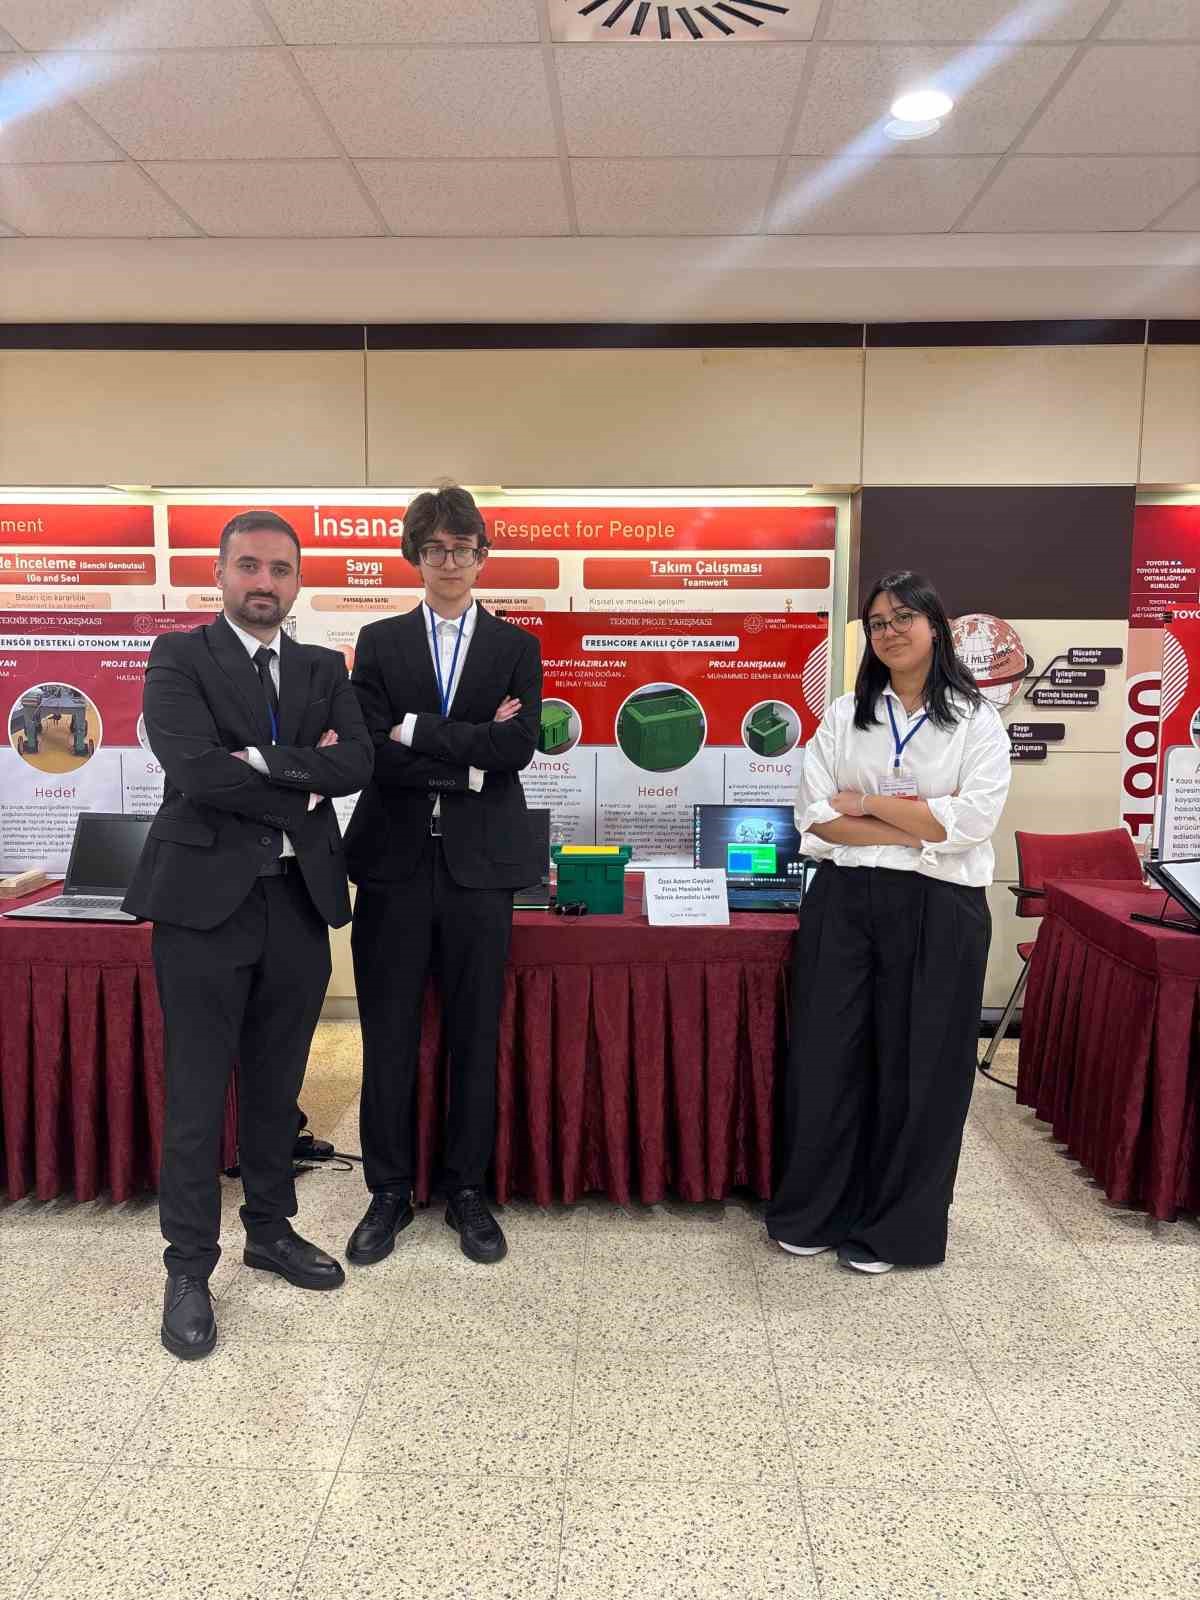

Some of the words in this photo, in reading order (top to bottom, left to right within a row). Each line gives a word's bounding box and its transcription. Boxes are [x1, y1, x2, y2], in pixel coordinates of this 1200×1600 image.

[0, 517, 44, 532] ment
[314, 505, 404, 537] İnsana
[494, 520, 570, 542] Respect
[575, 520, 604, 538] for
[609, 520, 676, 542] People
[15, 552, 77, 569] İnceleme
[346, 559, 383, 574] Saygı
[650, 560, 692, 574] Takım
[695, 560, 763, 576] Çalışması
[26, 574, 42, 583] (Go
[44, 574, 59, 583] and
[60, 574, 80, 583] See)
[348, 576, 382, 586] Respect
[682, 578, 729, 587] Teamwork
[30, 617, 57, 626] PROJE
[58, 617, 102, 628] YARIŞMASI
[34, 636, 76, 647] DESTEKLİ
[78, 639, 120, 648] OTONOM
[585, 640, 638, 648] FRESHCORE
[670, 638, 689, 650] ÇÖP
[692, 640, 736, 648] TASARIMI
[542, 658, 573, 668] ROJEYİ
[530, 760, 570, 774] Amaç
[749, 762, 792, 776] Sonuç
[35, 786, 77, 798] Hedef
[638, 786, 679, 797] Hedef
